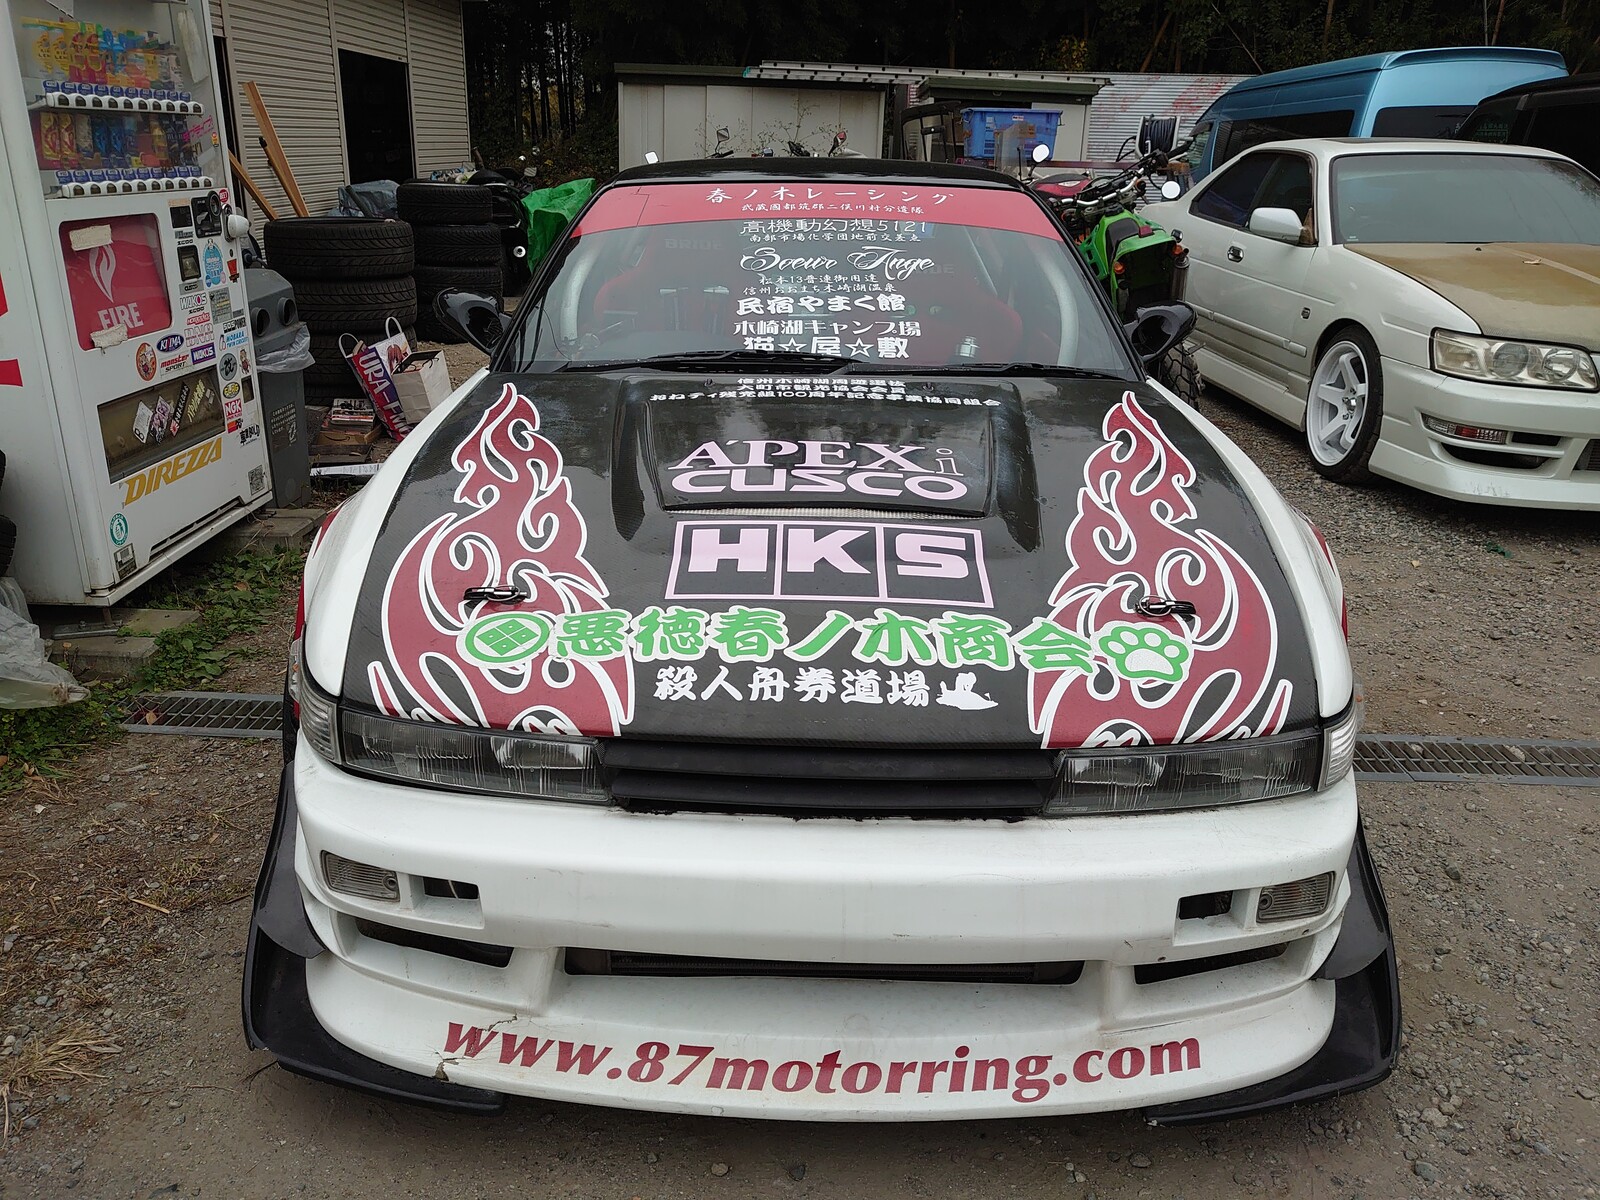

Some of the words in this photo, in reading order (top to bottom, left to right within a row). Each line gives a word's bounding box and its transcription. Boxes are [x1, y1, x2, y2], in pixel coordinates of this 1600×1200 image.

[705, 186, 954, 205] 春ノ木レーシング
[739, 218, 927, 235] 高機動幻想5121
[846, 246, 935, 281] Ange
[97, 302, 144, 330] FIRE
[736, 294, 906, 316] 民宿やまく館
[733, 319, 922, 337] 木崎湖キャンプ場
[124, 437, 223, 506] DIREZZA
[671, 468, 968, 500] CUSCO
[687, 527, 970, 579] HKS
[550, 605, 1100, 675] 悪徳春ノ木商会
[443, 1020, 1202, 1103] www.87motorring.com
